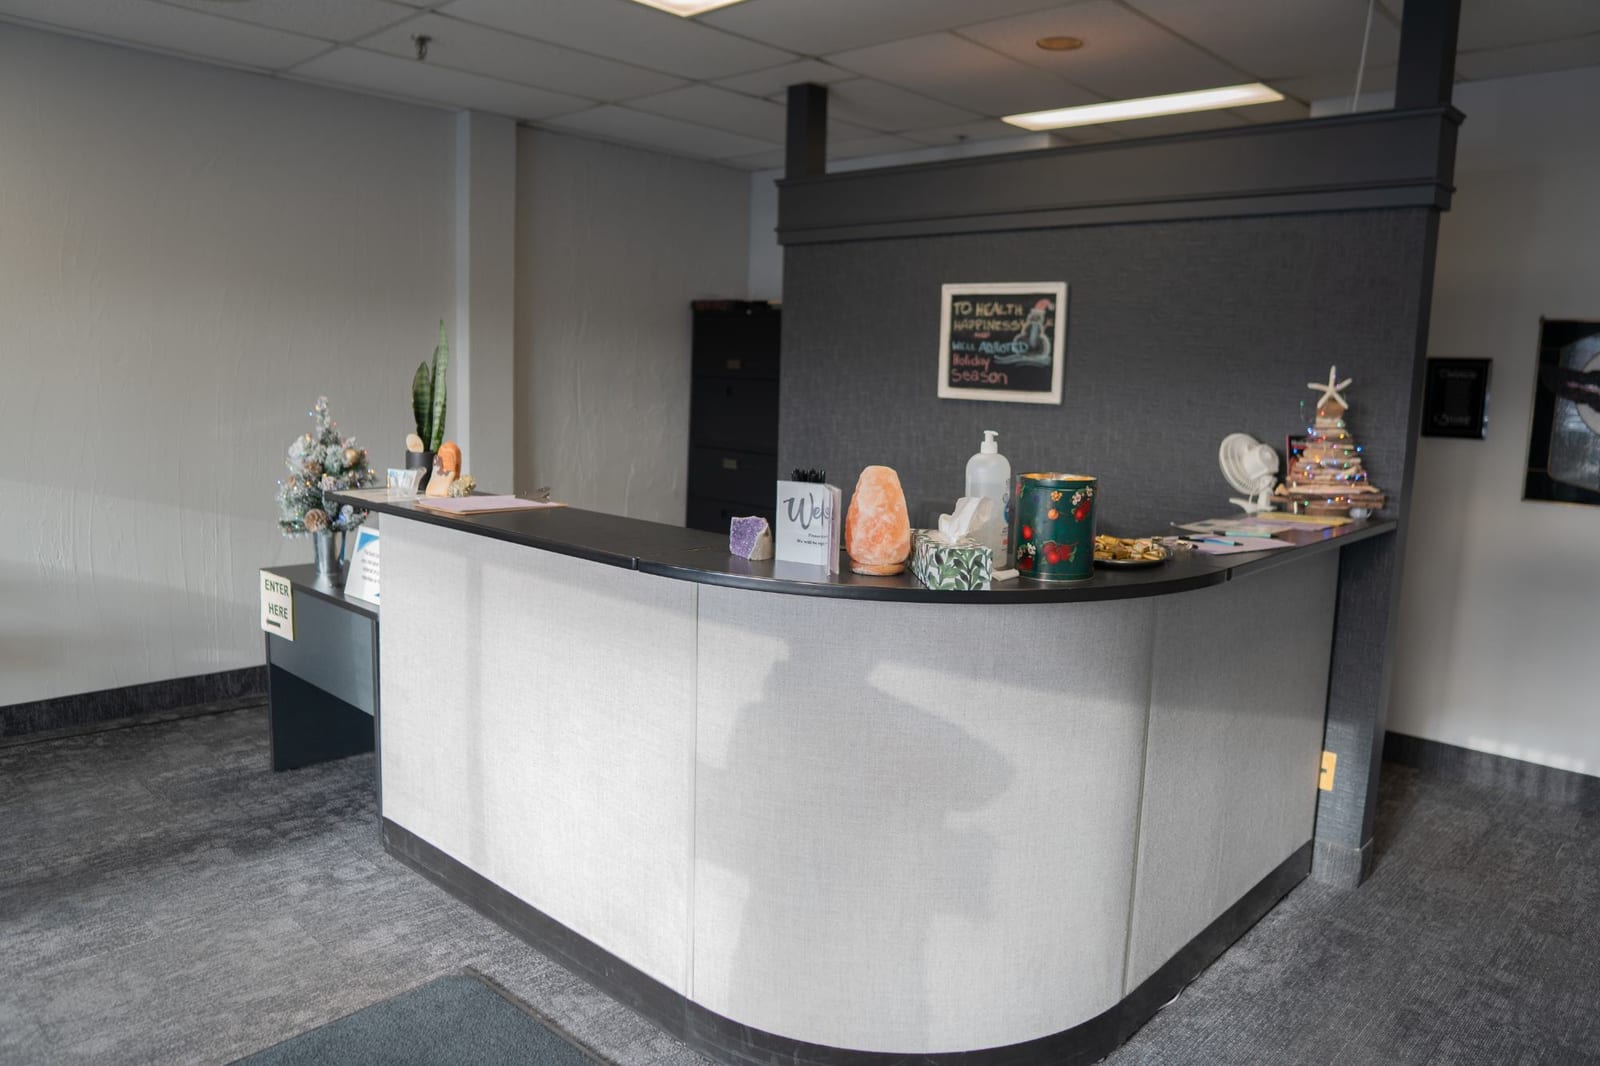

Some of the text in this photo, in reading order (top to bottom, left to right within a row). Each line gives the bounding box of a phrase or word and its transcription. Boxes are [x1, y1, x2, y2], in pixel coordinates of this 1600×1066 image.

[954, 301, 1024, 316] TO HEALTH
[951, 368, 1008, 385] Season
[265, 579, 289, 597] ENTER
[268, 602, 289, 620] HERE
